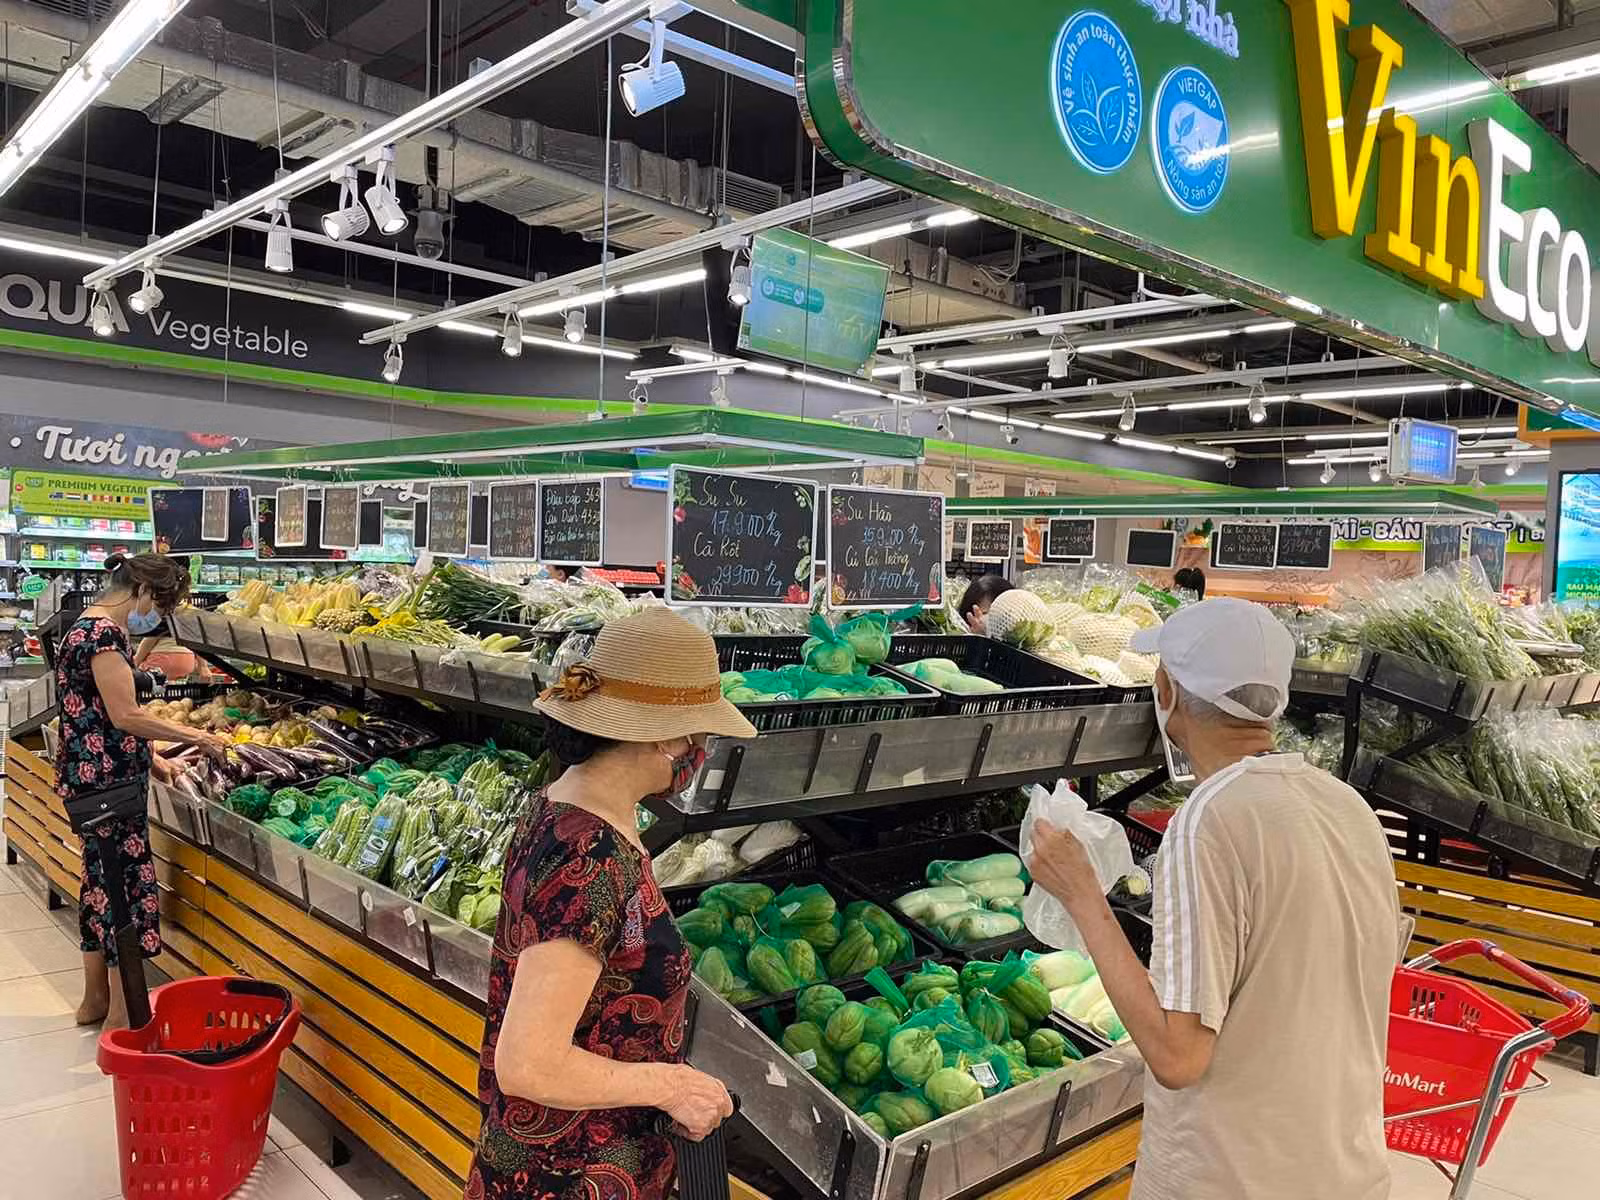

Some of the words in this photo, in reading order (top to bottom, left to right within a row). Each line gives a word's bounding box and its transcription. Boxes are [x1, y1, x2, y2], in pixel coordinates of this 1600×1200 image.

[1063, 42, 1078, 81] sinh
[1076, 27, 1090, 45] an
[1091, 23, 1116, 49] toàn
[1178, 77, 1217, 111] VIETGAP
[1166, 159, 1190, 200] Nông
[1207, 178, 1218, 196] an
[1287, 0, 1591, 351] VinEco
[150, 310, 308, 358] Vegetable
[36, 426, 127, 465] Tươi
[48, 479, 97, 491] PREMIUM
[847, 495, 864, 521] Su
